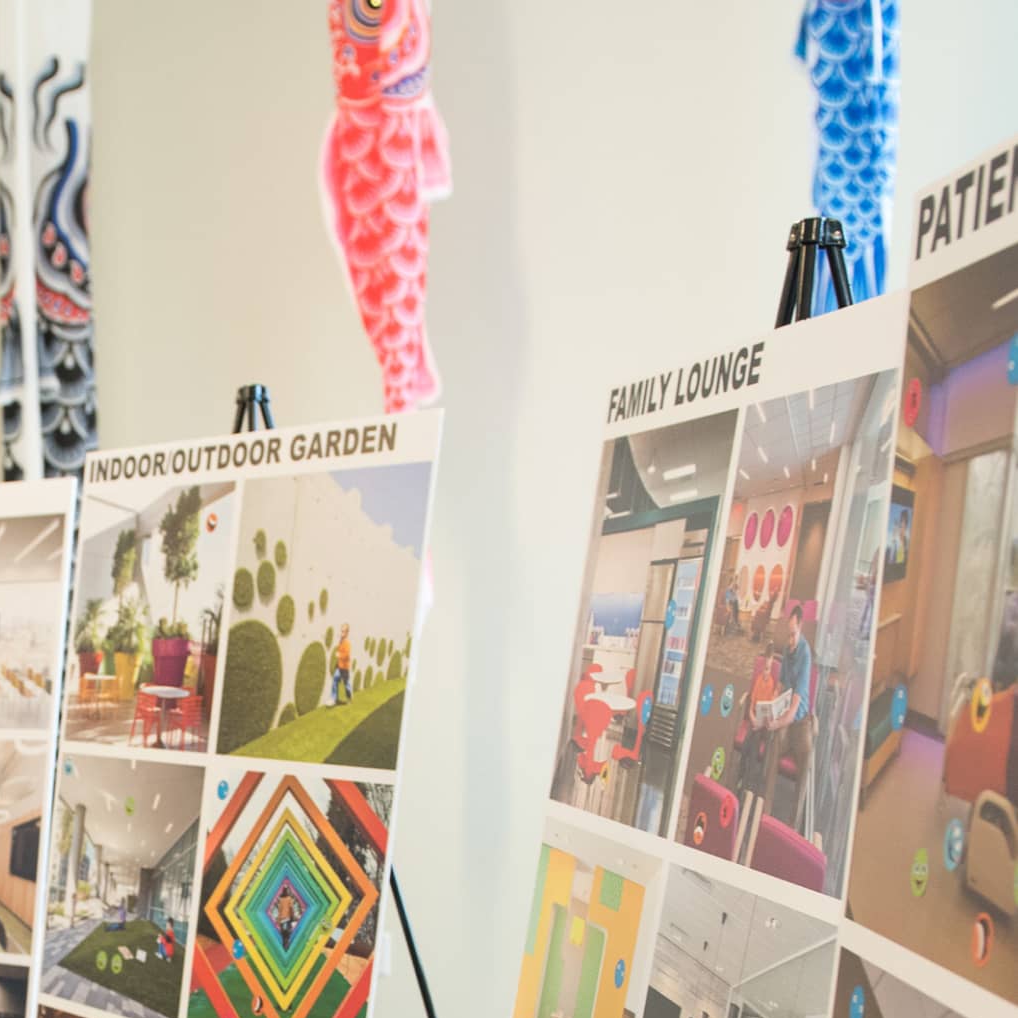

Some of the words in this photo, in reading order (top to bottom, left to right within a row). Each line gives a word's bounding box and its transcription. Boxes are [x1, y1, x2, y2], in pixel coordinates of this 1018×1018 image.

[606, 370, 672, 424] FAMILY
[674, 341, 766, 406] LOUNGE
[88, 436, 282, 484] INDOOR/OUTDOOR
[290, 421, 399, 462] GARDEN
